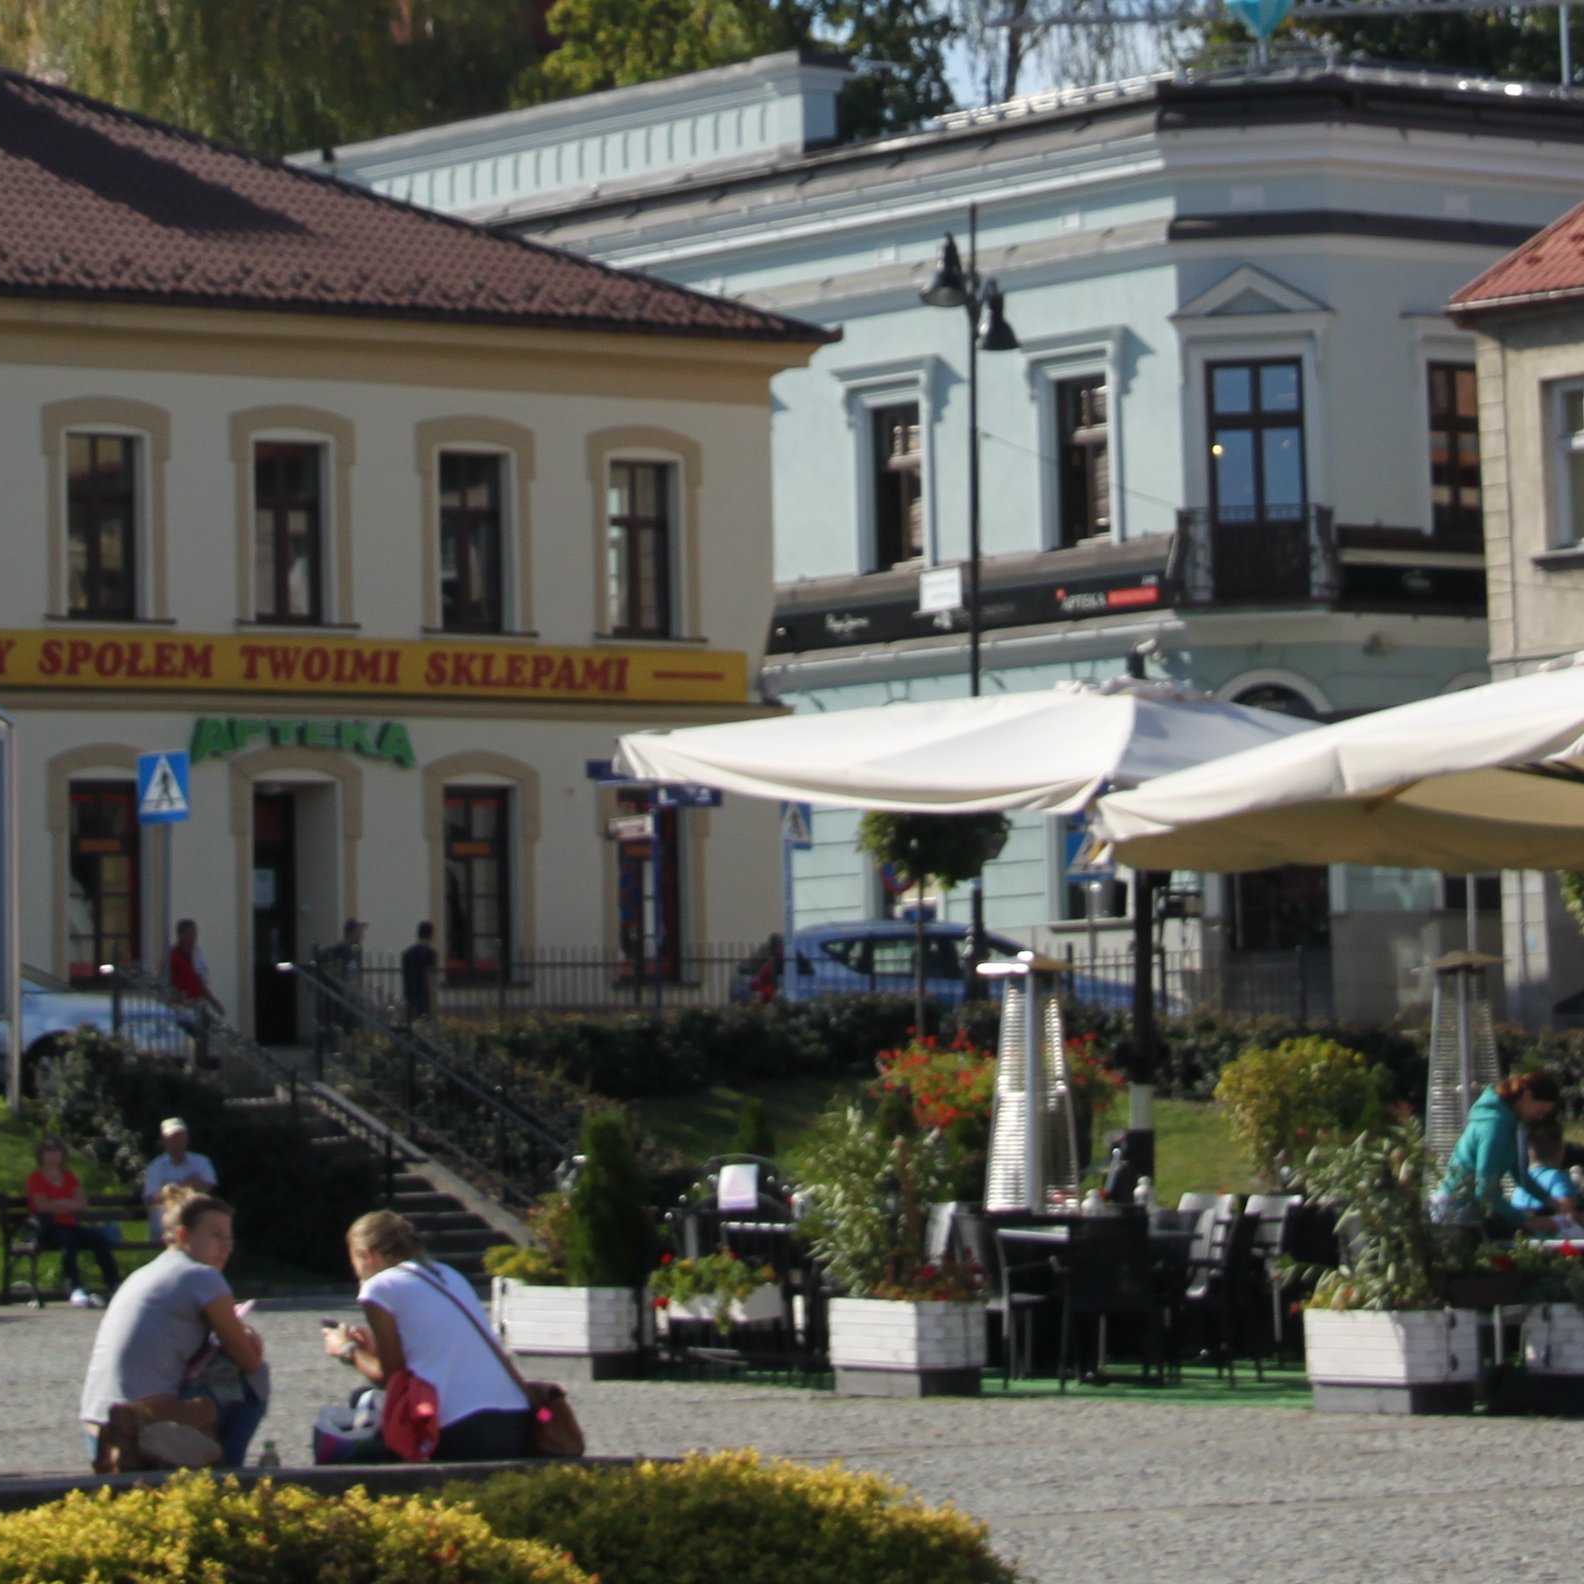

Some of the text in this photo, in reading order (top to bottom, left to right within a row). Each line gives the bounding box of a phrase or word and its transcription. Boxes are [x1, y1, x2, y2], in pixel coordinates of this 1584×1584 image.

[38, 639, 215, 679] SPOŁEM
[240, 644, 402, 685] TWOIMI
[425, 651, 630, 692] SKLEPAMI
[190, 718, 415, 769] APTEKA
